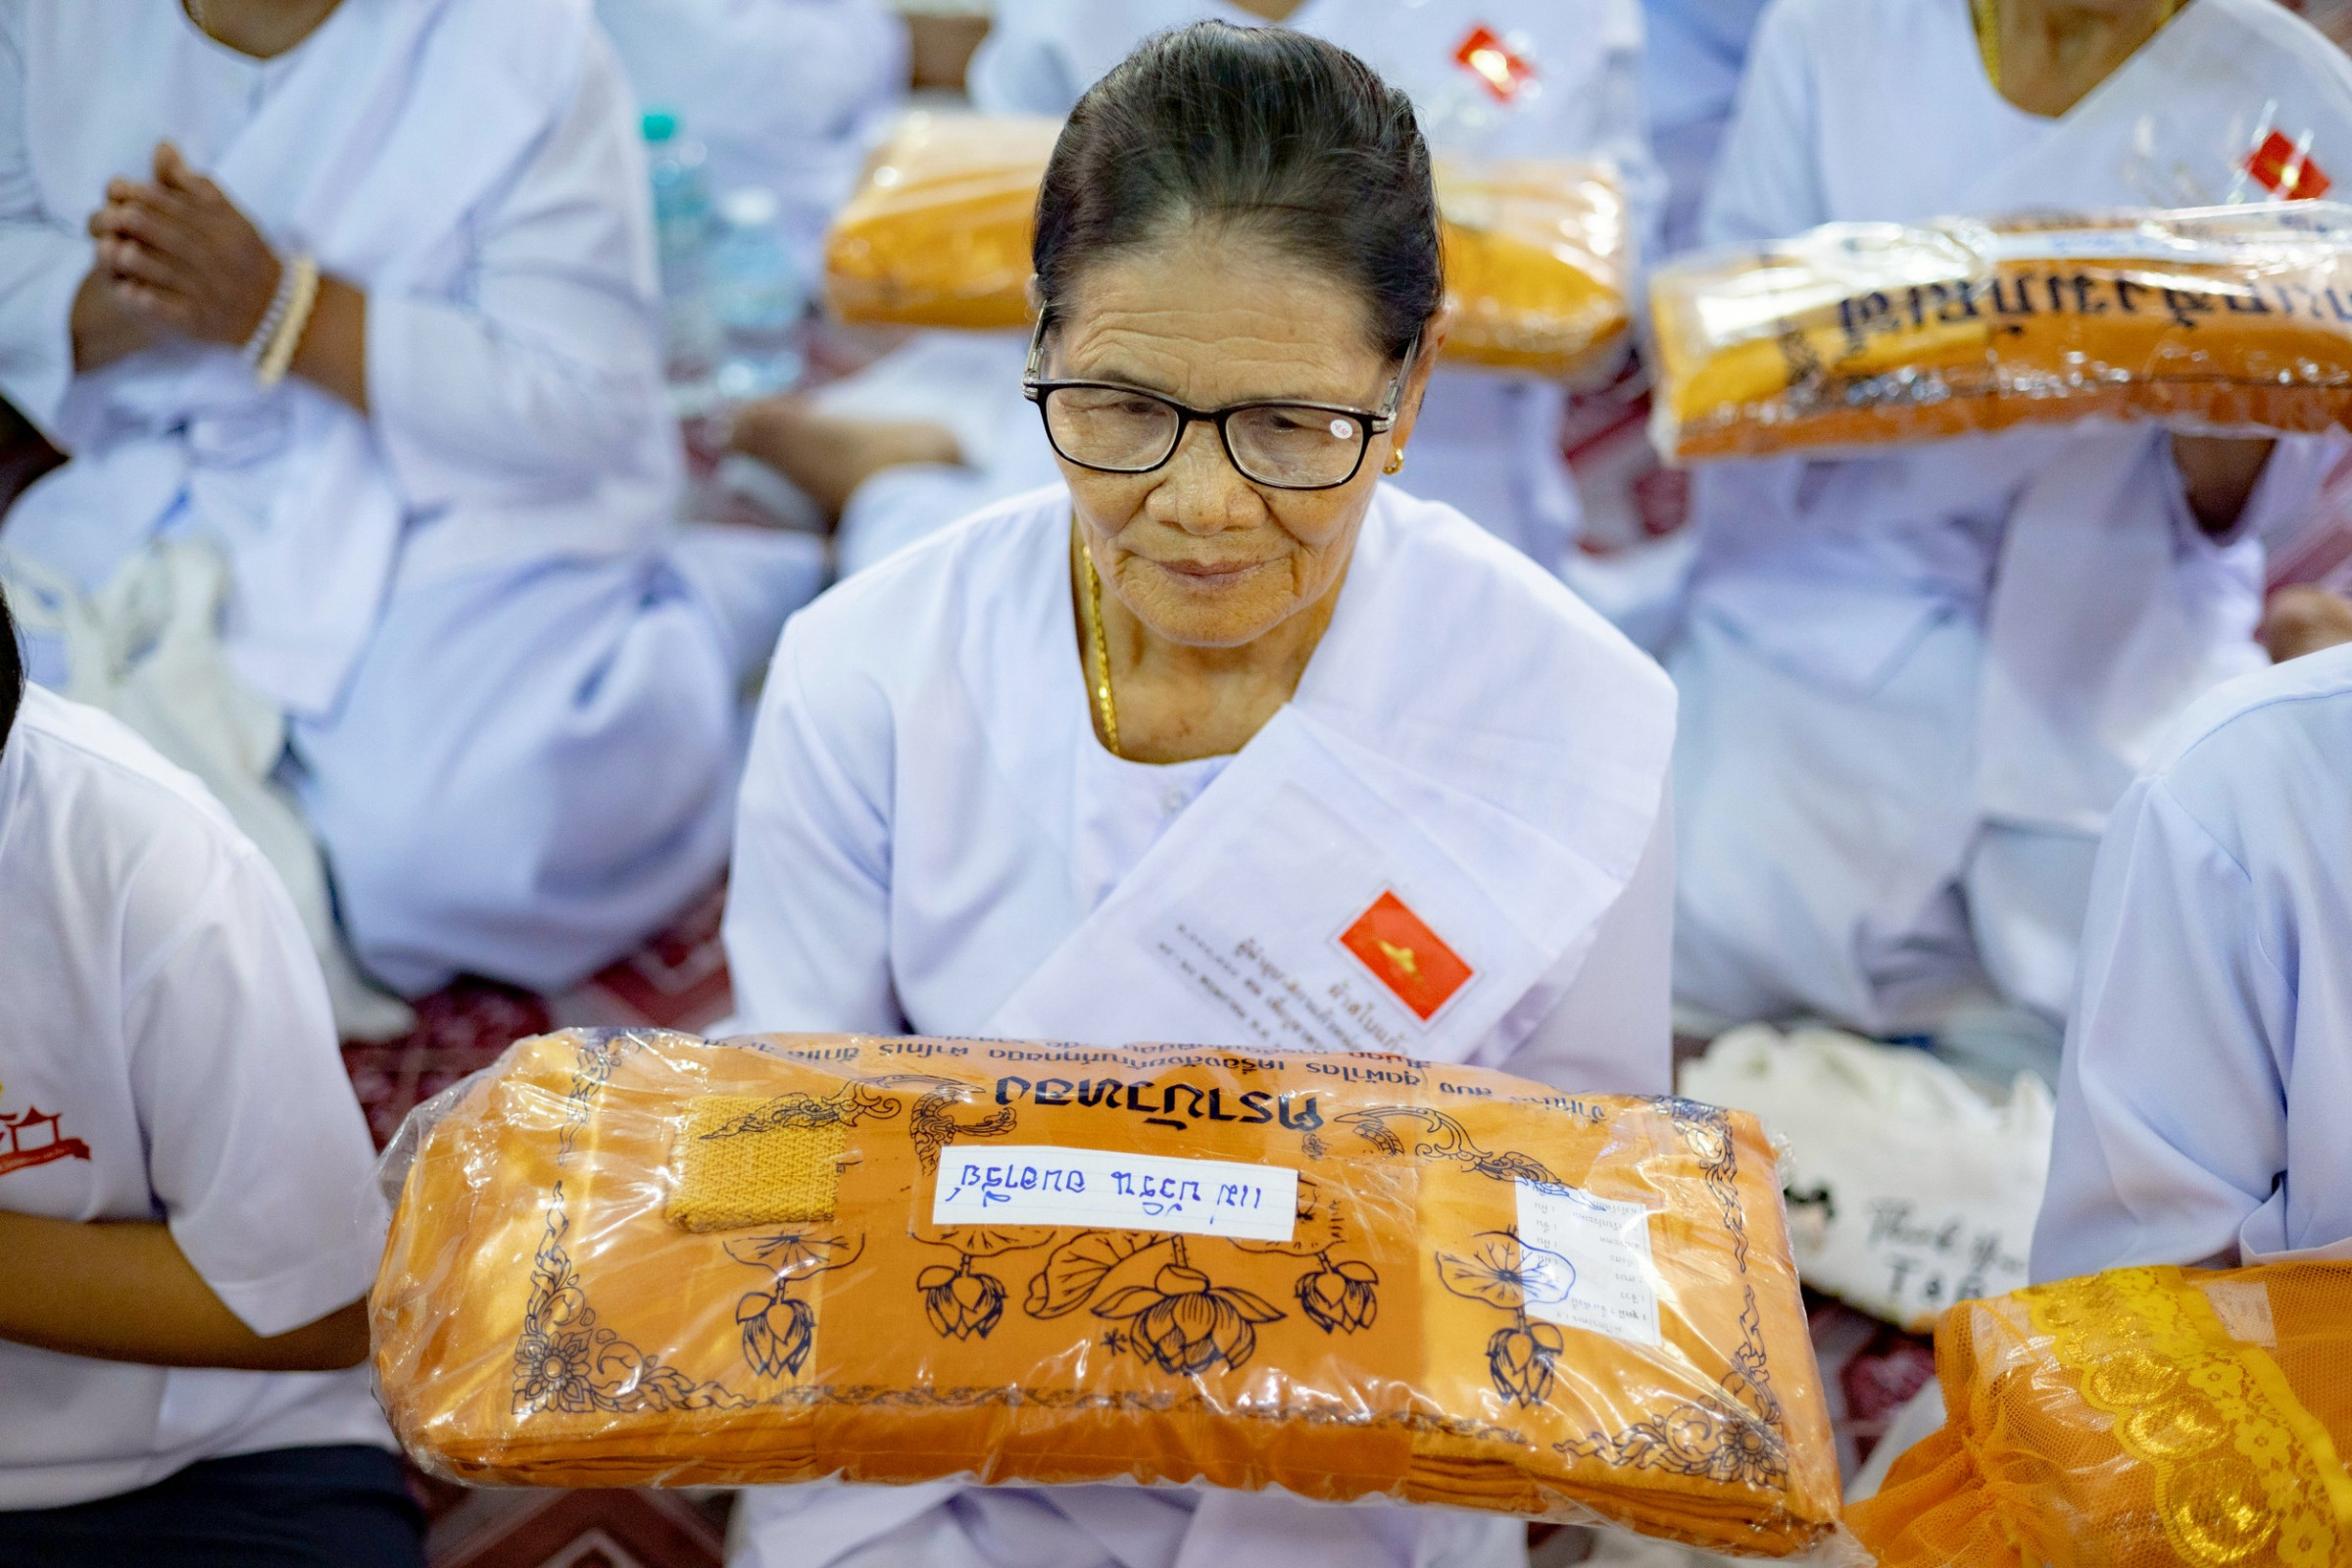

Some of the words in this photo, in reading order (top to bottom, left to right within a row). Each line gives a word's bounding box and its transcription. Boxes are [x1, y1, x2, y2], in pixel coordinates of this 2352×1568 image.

[995, 1075, 1322, 1131] ตราบัวทอง
[1210, 1183, 1261, 1225] แม่
